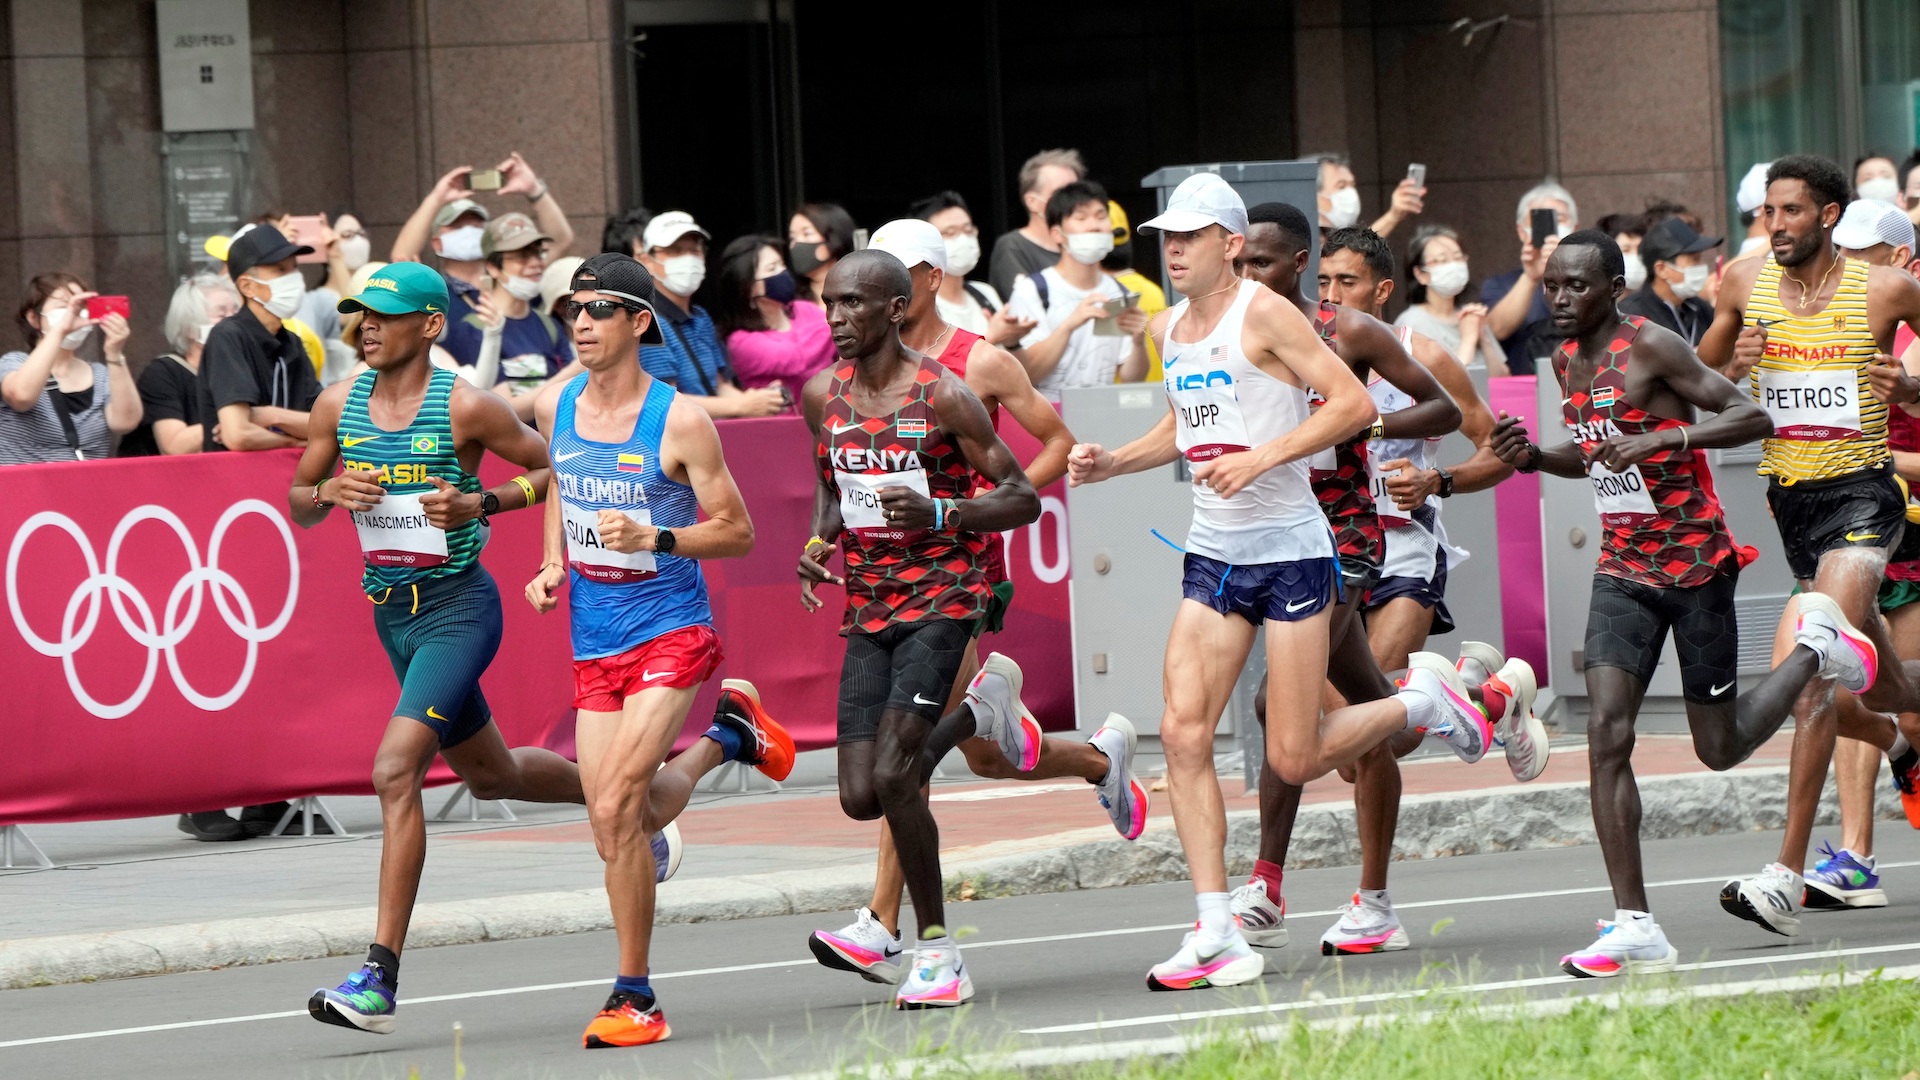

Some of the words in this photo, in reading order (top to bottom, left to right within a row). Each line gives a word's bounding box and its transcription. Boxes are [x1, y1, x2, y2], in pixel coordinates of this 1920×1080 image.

[1764, 342, 1849, 361] ERMANY
[1766, 386, 1848, 409] PETROS
[1181, 404, 1219, 428] RUPP
[1566, 418, 1624, 444] ENYA
[829, 447, 922, 471] KENYA
[556, 471, 648, 504] COLOMBIA
[1591, 472, 1641, 498] RONO
[847, 487, 882, 509] KIPCH
[364, 514, 428, 529] NASCIMENT
[567, 519, 606, 549] SUA
